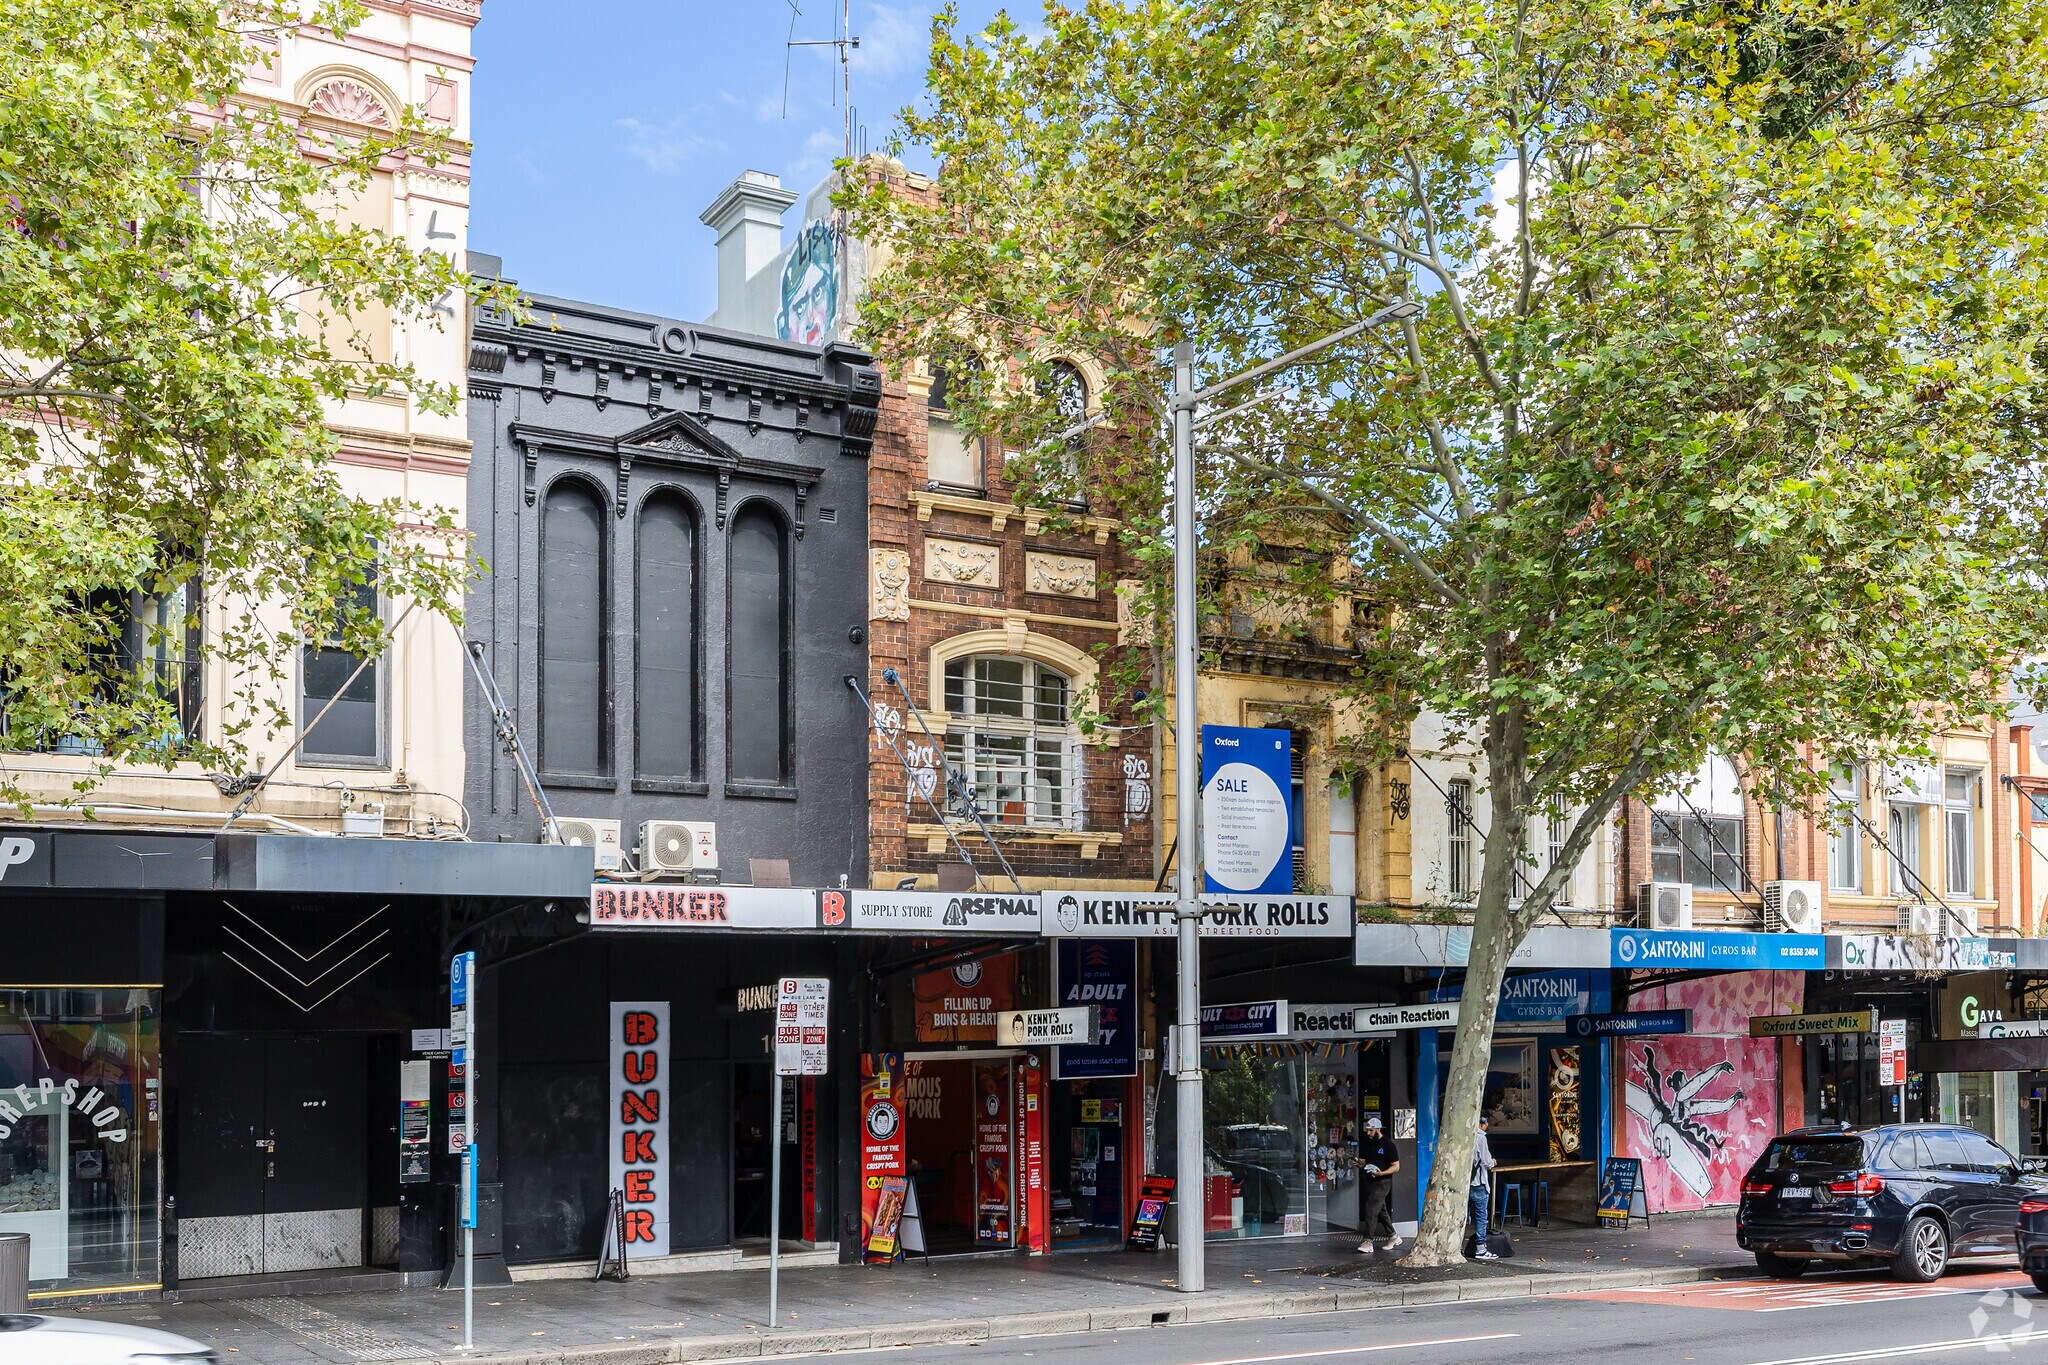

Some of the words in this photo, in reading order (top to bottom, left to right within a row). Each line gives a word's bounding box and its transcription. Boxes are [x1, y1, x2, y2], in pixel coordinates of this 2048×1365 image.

[1214, 738, 1239, 746] Oxford
[1216, 778, 1248, 792] SALE
[595, 889, 728, 922] BUNKER
[822, 891, 846, 926] B
[861, 904, 899, 917] SUPPLY
[902, 905, 932, 918] STORE
[1083, 900, 1178, 926] KENNY'
[1267, 902, 1330, 927] ROLLS
[1640, 938, 1704, 960] SANTORINI
[1712, 946, 1739, 955] GYROS
[1741, 946, 1756, 956] BAR
[1781, 948, 1788, 956] 02
[786, 981, 795, 993] B
[1067, 984, 1127, 1000] ADULT
[1503, 977, 1577, 1000] SANTORINI
[738, 984, 778, 1012] BUNKE
[944, 998, 978, 1010] FILLING
[980, 998, 992, 1010] UP
[934, 1013, 958, 1026] BUNS
[960, 1014, 967, 1026] &
[1028, 1012, 1059, 1026] KENNY'S
[1200, 1008, 1222, 1022] ULT
[1248, 1005, 1274, 1020] CITY
[1369, 1012, 1398, 1026] Chain
[1400, 1008, 1450, 1022] Reaction
[1518, 1007, 1545, 1016] GYROS
[1547, 1007, 1563, 1016] BAR
[1960, 996, 2003, 1028] GAYA
[1294, 1011, 1354, 1031] Reacti
[1595, 1019, 1637, 1031] SANTORINI
[1762, 1020, 1795, 1032] Oxford
[1798, 1018, 1833, 1030] Sweet
[1837, 1016, 1859, 1028] Mix
[1028, 1026, 1048, 1037] PORK
[1051, 1023, 1073, 1035] ROLLS
[1989, 1026, 2031, 1038] GAYA
[913, 1061, 923, 1075] OF
[904, 1077, 942, 1098] MOUS
[909, 1099, 941, 1118] PORK
[1019, 1107, 1025, 1118] OF
[620, 1012, 660, 1243] BUNKER
[804, 1109, 813, 1194] BUNKER
